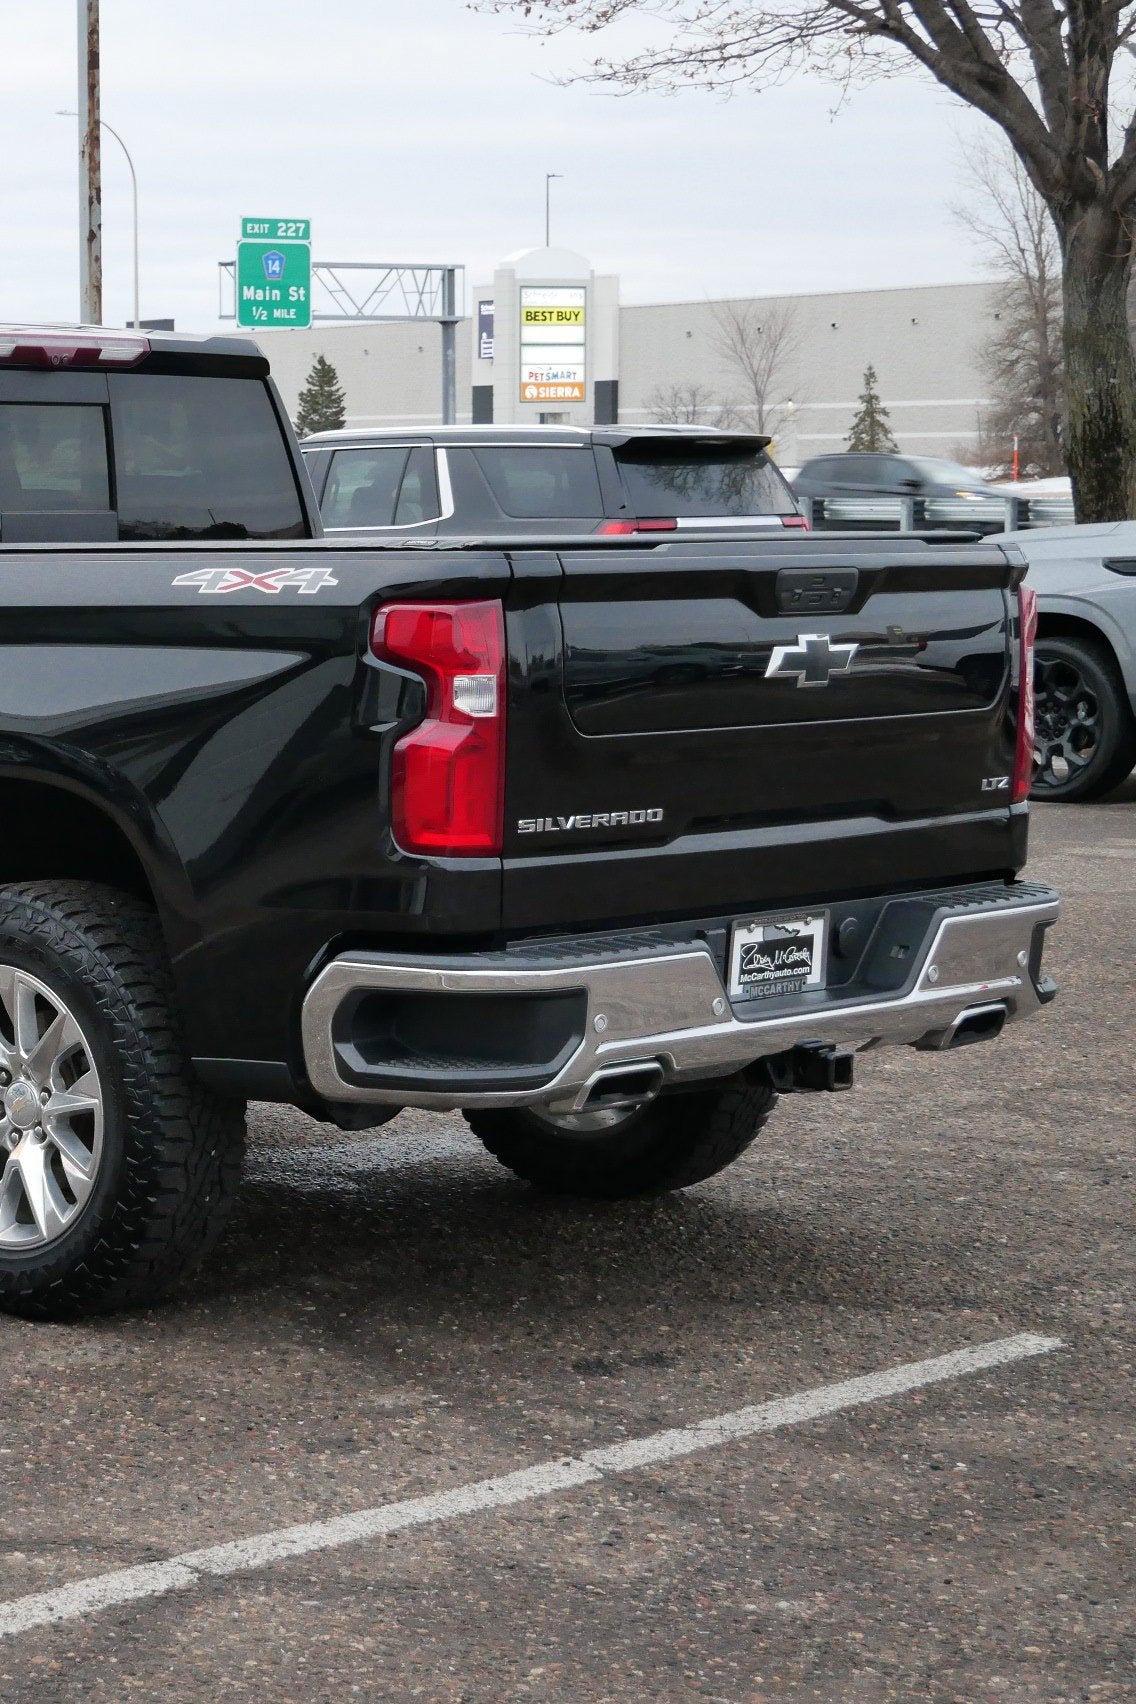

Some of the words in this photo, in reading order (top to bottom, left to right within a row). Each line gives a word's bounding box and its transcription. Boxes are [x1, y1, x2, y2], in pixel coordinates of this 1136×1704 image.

[246, 223, 270, 234] EXIT
[276, 222, 306, 237] 227
[267, 260, 280, 274] 14
[242, 285, 281, 301] Main
[288, 286, 306, 301] St
[273, 308, 296, 319] MILE
[525, 310, 554, 322] BEST
[556, 310, 581, 322] BUY
[538, 386, 581, 398] SIERRA
[981, 776, 1009, 791] LTZ
[517, 808, 664, 834] SILVERADO
[739, 966, 810, 983] McCarthyauto.com
[750, 981, 802, 998] MCCARTHY
